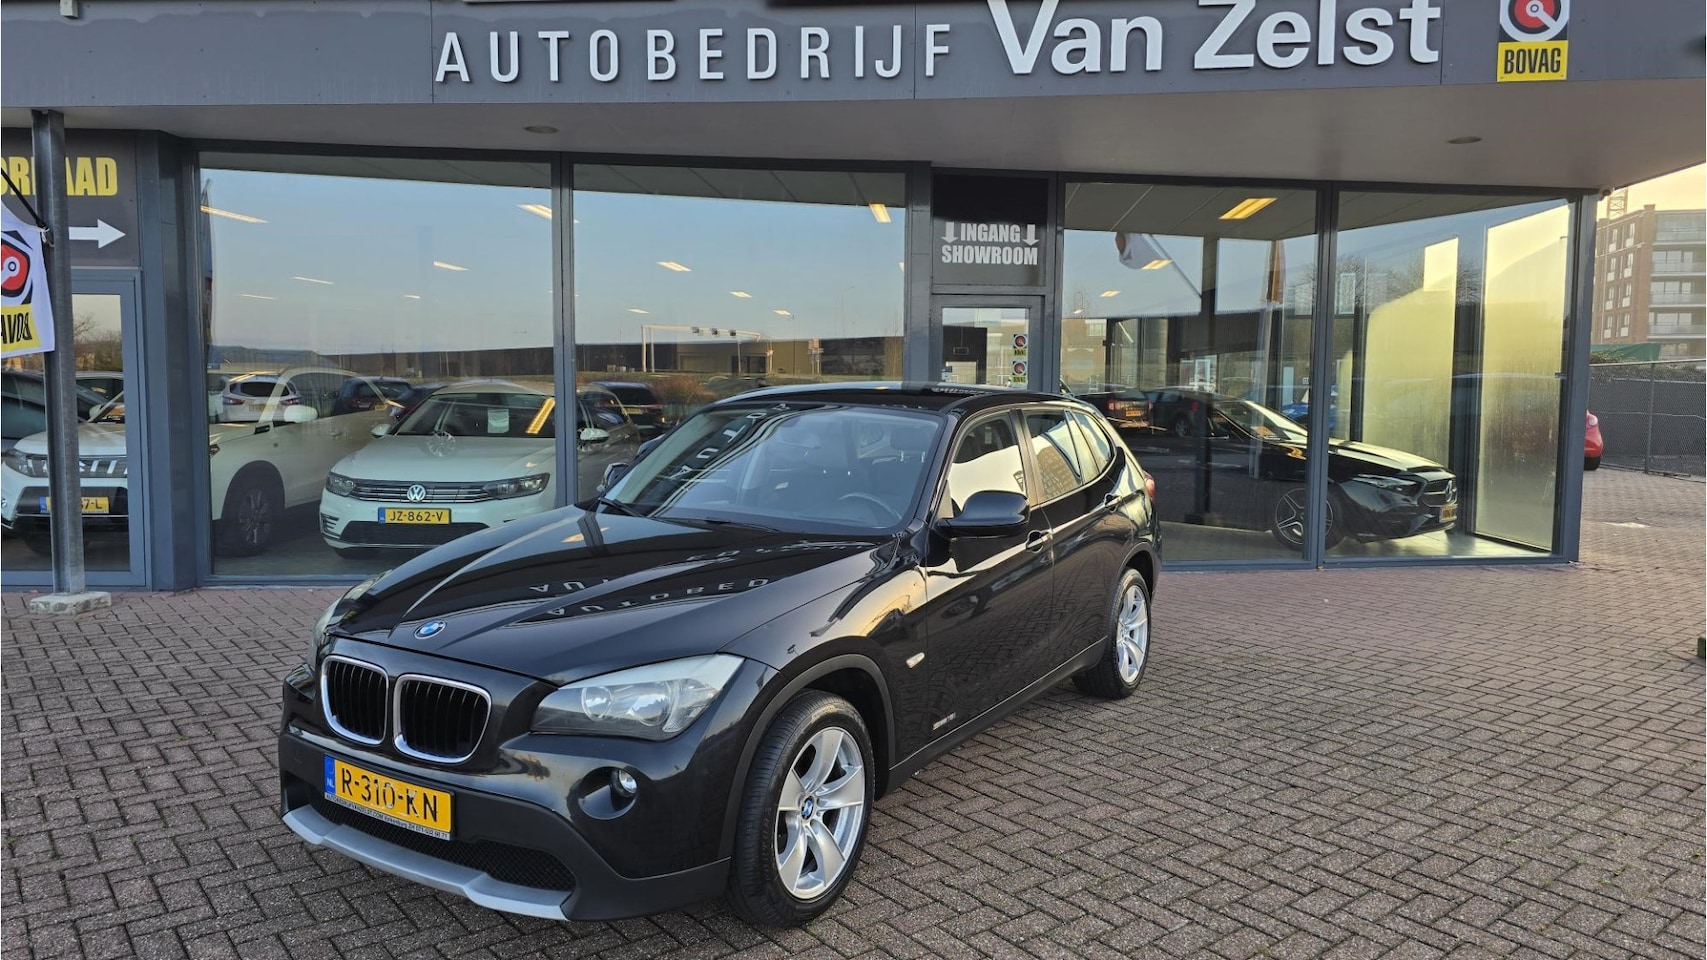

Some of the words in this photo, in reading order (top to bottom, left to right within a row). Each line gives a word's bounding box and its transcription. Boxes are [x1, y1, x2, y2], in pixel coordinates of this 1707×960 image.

[434, 24, 950, 82] AUTOBEDRIJF
[987, 0, 1163, 74] Van
[1194, 0, 1441, 69] Zelst
[1504, 47, 1561, 74] BOVAG
[960, 223, 1020, 242] INGANG
[941, 244, 1038, 265] SHOWROOM
[390, 511, 443, 522] JZ-862-V
[341, 767, 438, 822] R-310-KN
